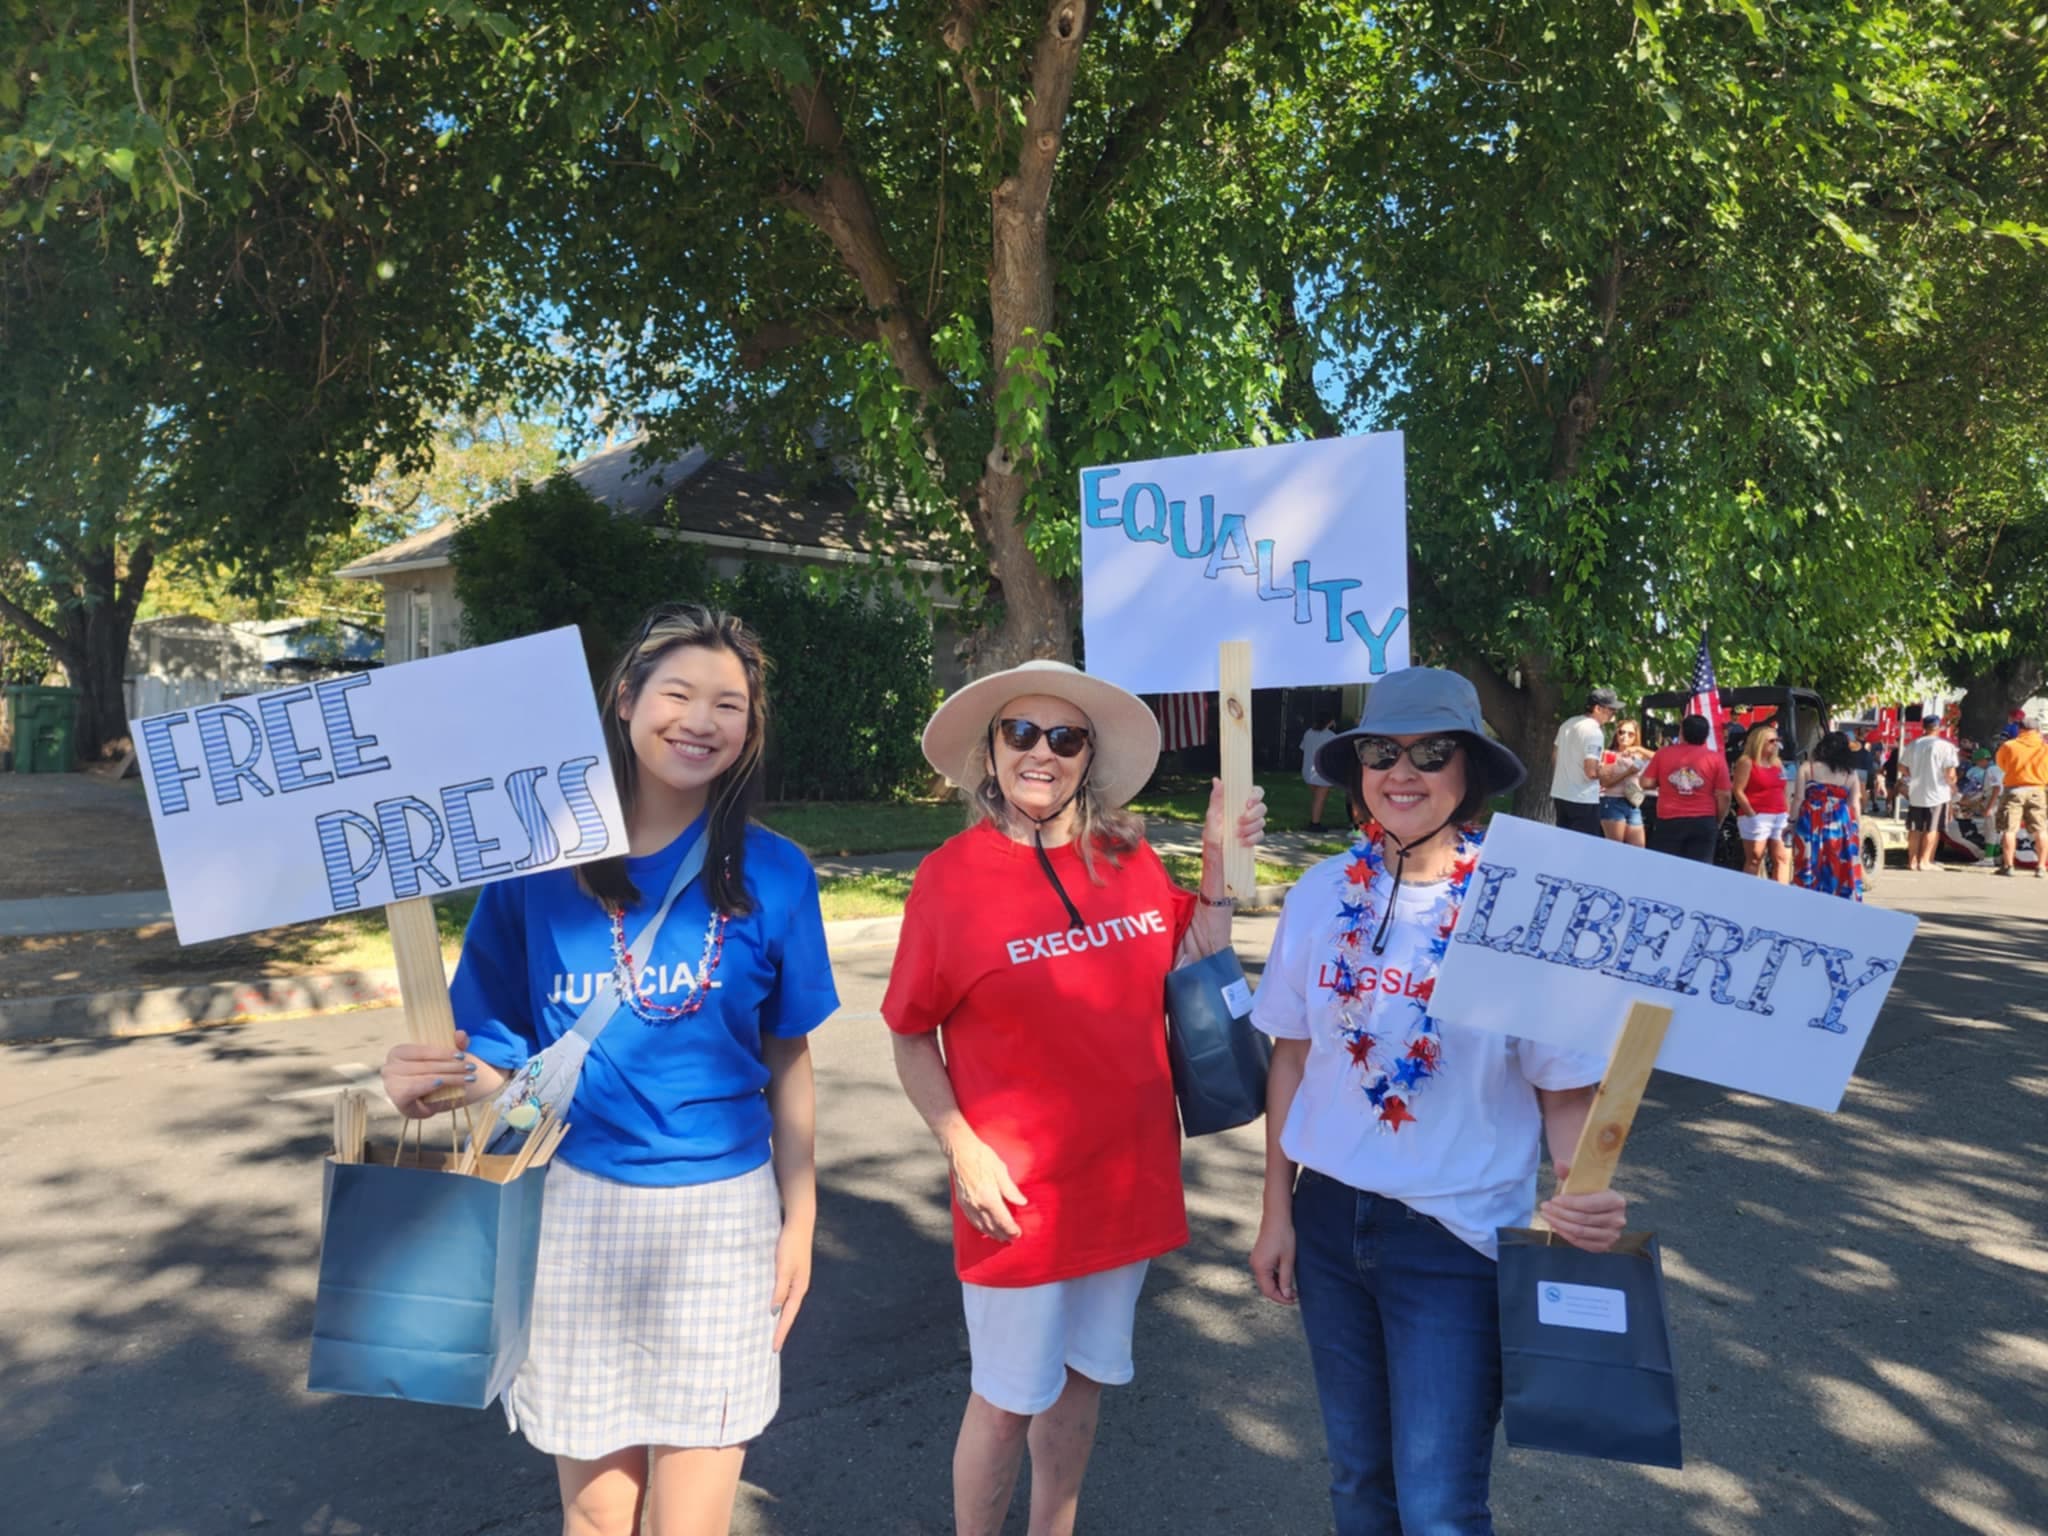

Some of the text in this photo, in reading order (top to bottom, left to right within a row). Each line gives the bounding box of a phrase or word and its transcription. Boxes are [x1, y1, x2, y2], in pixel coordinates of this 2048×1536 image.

[1082, 468, 1408, 675] EQUALITY
[141, 672, 392, 817] FREE
[315, 755, 610, 911] PRESS
[547, 961, 722, 1005] JUCIAL
[1006, 909, 1167, 965] EXECUTIVE
[1455, 862, 1898, 1034] LIBERTY
